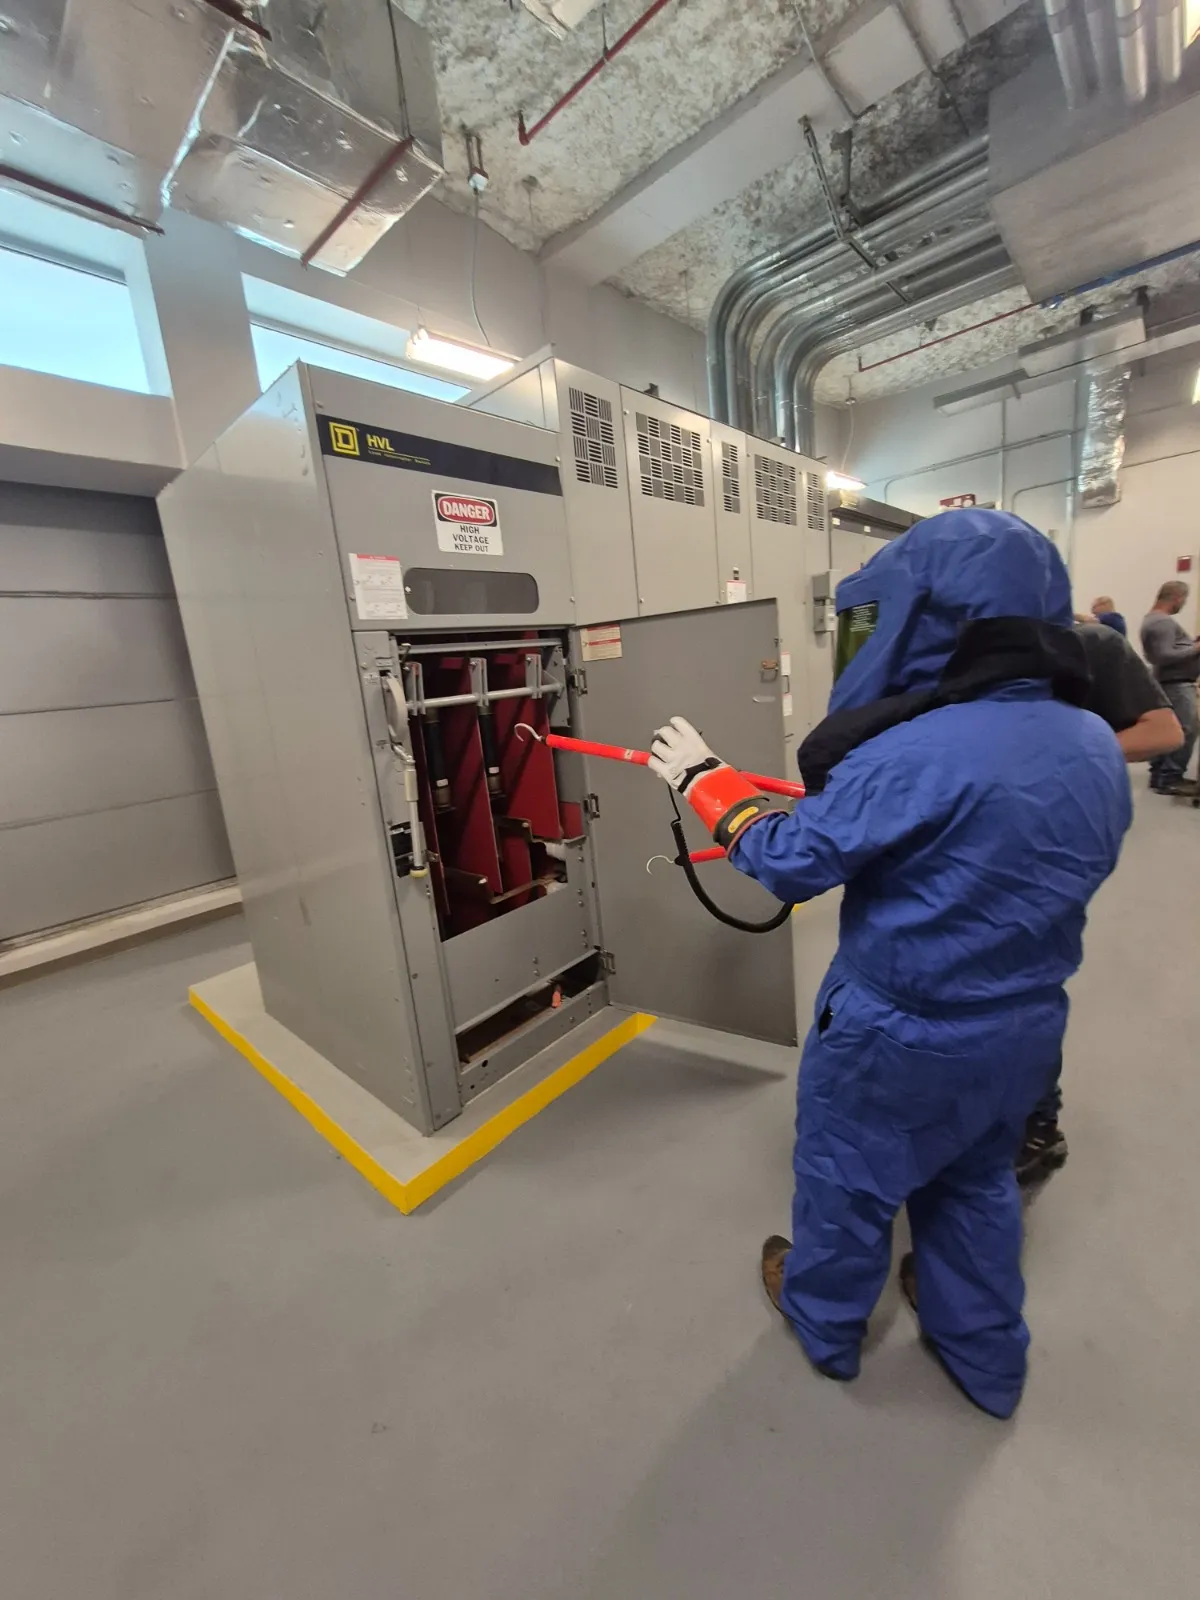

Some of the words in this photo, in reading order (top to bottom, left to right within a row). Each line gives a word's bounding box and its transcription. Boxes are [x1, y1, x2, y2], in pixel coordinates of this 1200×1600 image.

[366, 433, 395, 452] HVL
[442, 500, 490, 521] DANGER
[460, 524, 480, 534] HIGH
[452, 533, 490, 544] VOLTAGE
[454, 543, 473, 551] KEEP
[475, 544, 488, 552] OUT
